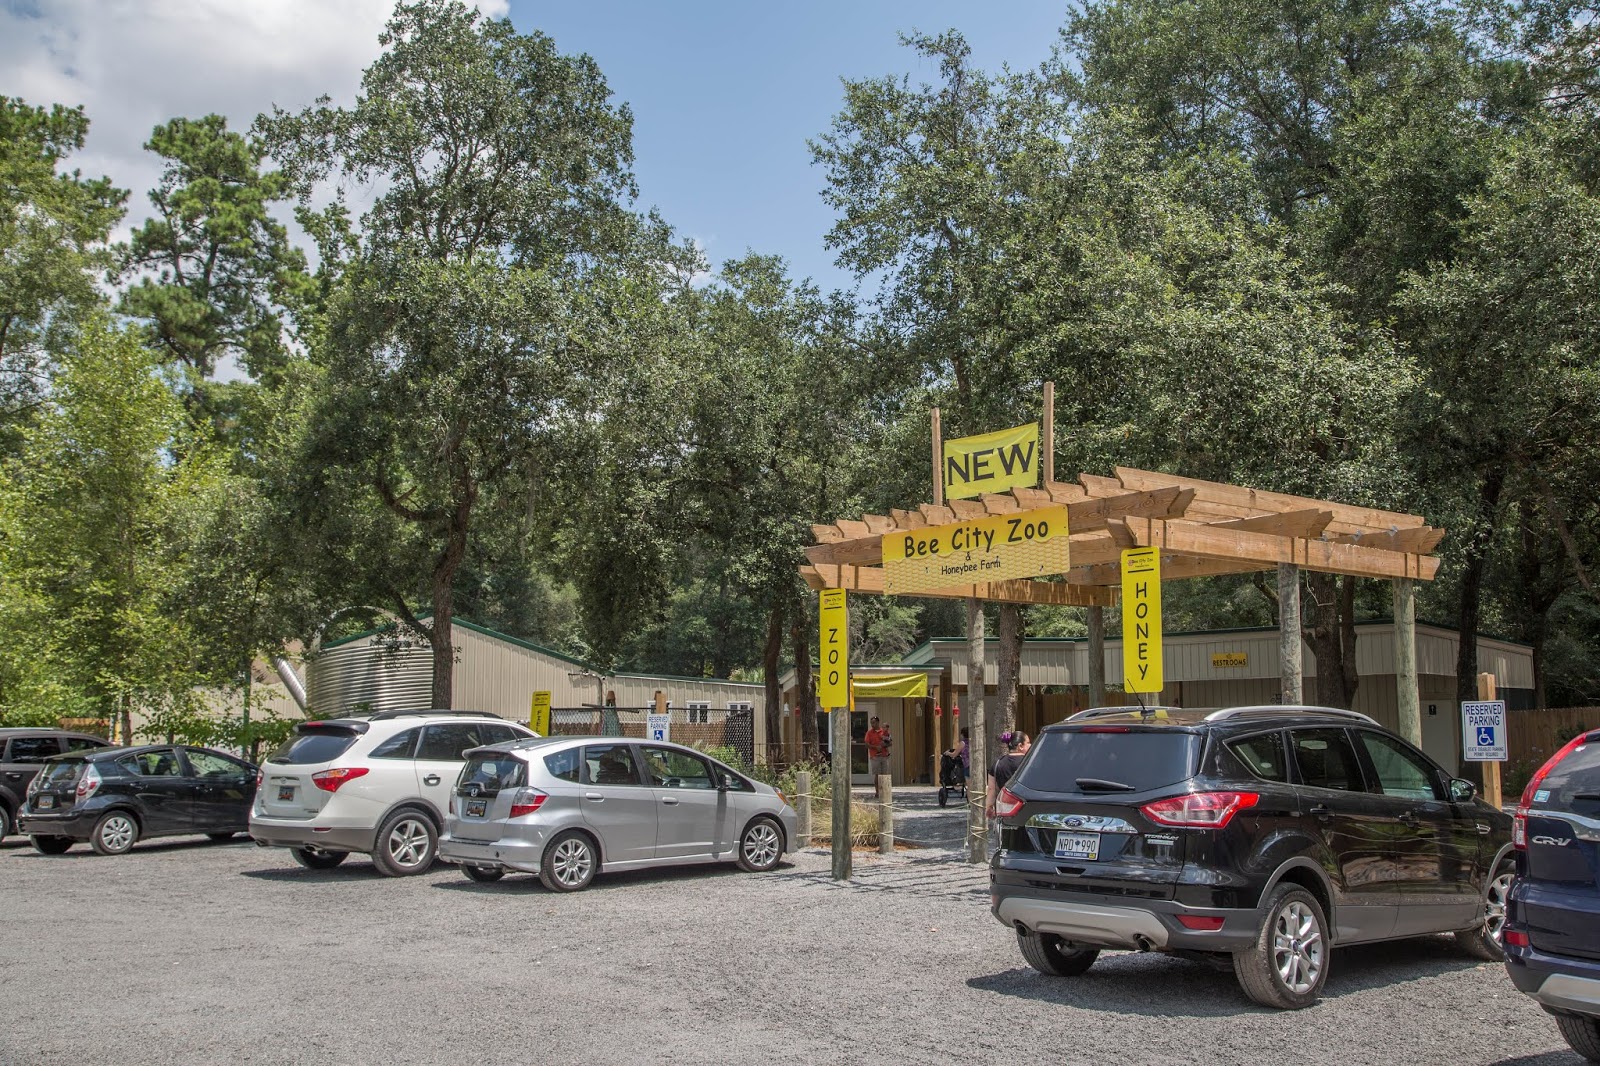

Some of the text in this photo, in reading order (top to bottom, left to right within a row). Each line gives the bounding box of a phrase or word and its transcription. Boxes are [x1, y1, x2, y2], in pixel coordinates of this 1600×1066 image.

[947, 440, 1036, 486] NEW
[905, 518, 1049, 558] Bee City Zoo
[965, 552, 972, 561] &
[941, 558, 1001, 576] Honeybee Farm
[1135, 581, 1149, 680] HONEY
[828, 628, 839, 686] ZOO
[1212, 658, 1246, 667] RESTROOMS
[1465, 704, 1502, 715] RESERVED
[648, 715, 668, 723] RESERVED
[1469, 715, 1500, 726] PARKING
[650, 722, 667, 730] PARKING
[1058, 838, 1096, 852] NRD 990
